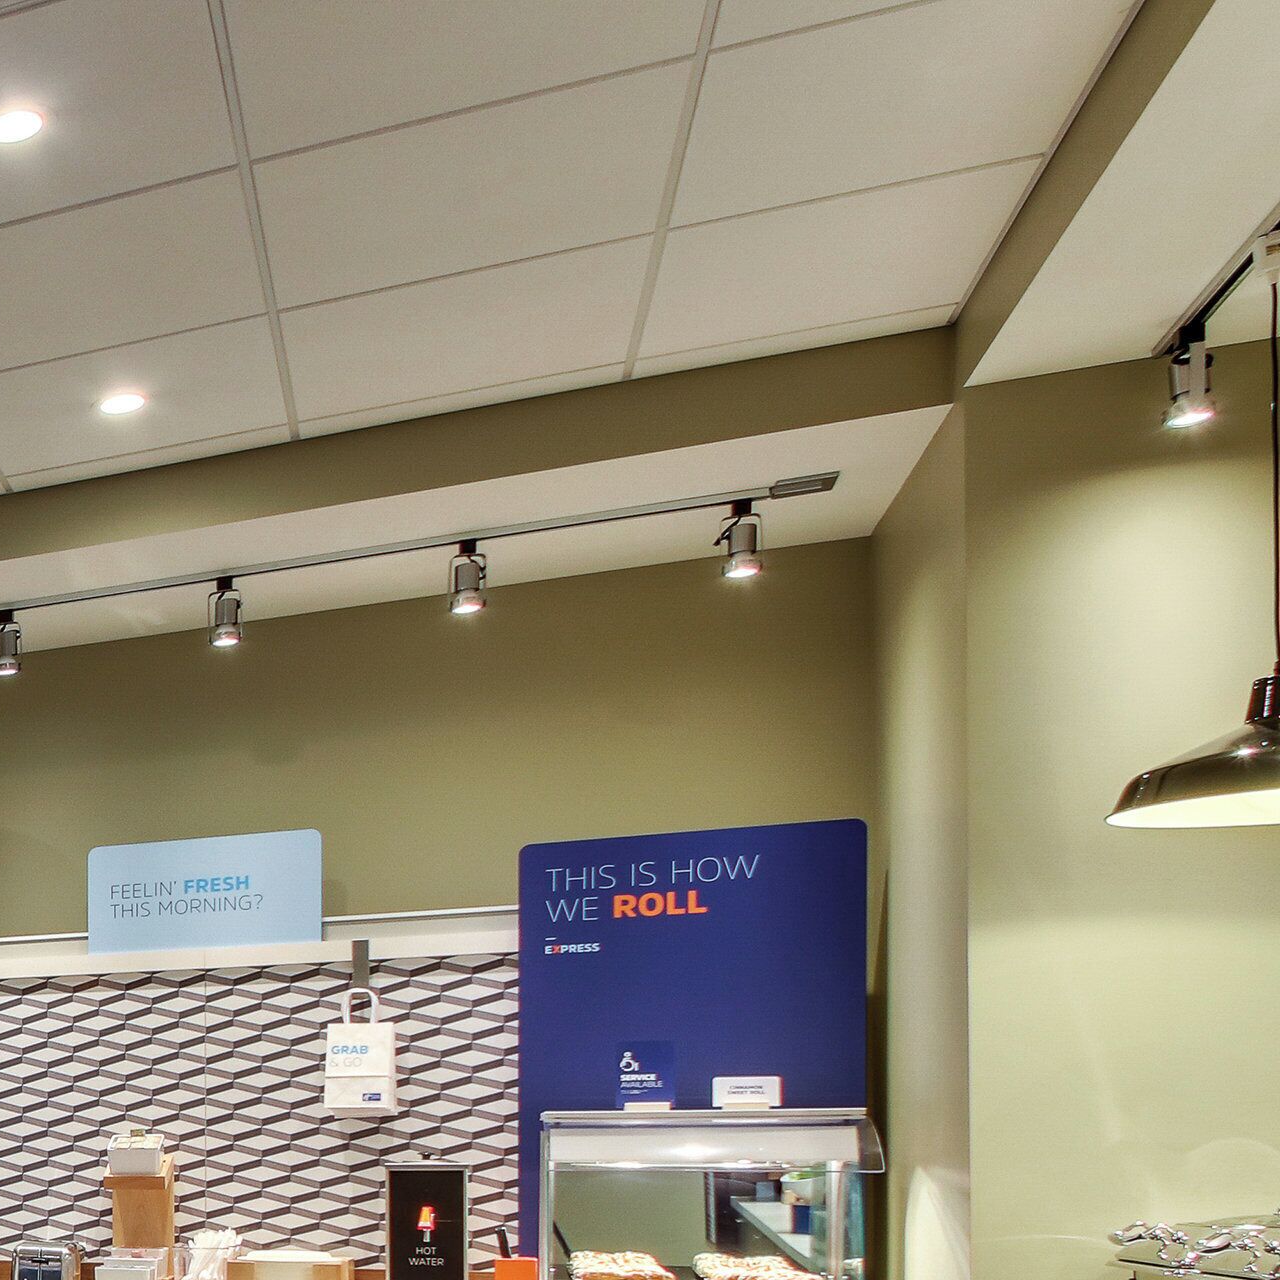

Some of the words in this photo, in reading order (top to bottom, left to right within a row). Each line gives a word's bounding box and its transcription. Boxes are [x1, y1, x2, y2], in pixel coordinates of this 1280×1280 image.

[544, 864, 617, 892] THIS
[630, 861, 657, 887] IS
[671, 854, 760, 884] HOW
[183, 875, 249, 894] FRESH
[110, 901, 152, 919] THIS
[158, 893, 264, 917] MORNING?
[545, 896, 599, 923] WE
[612, 889, 708, 919] ROLL
[544, 942, 601, 955] EXPRESS
[331, 1045, 369, 1055] GRAB
[343, 1056, 363, 1067] GO
[620, 1073, 657, 1082] SERVICE
[415, 1246, 437, 1255] HOT
[408, 1257, 445, 1266] WATER
